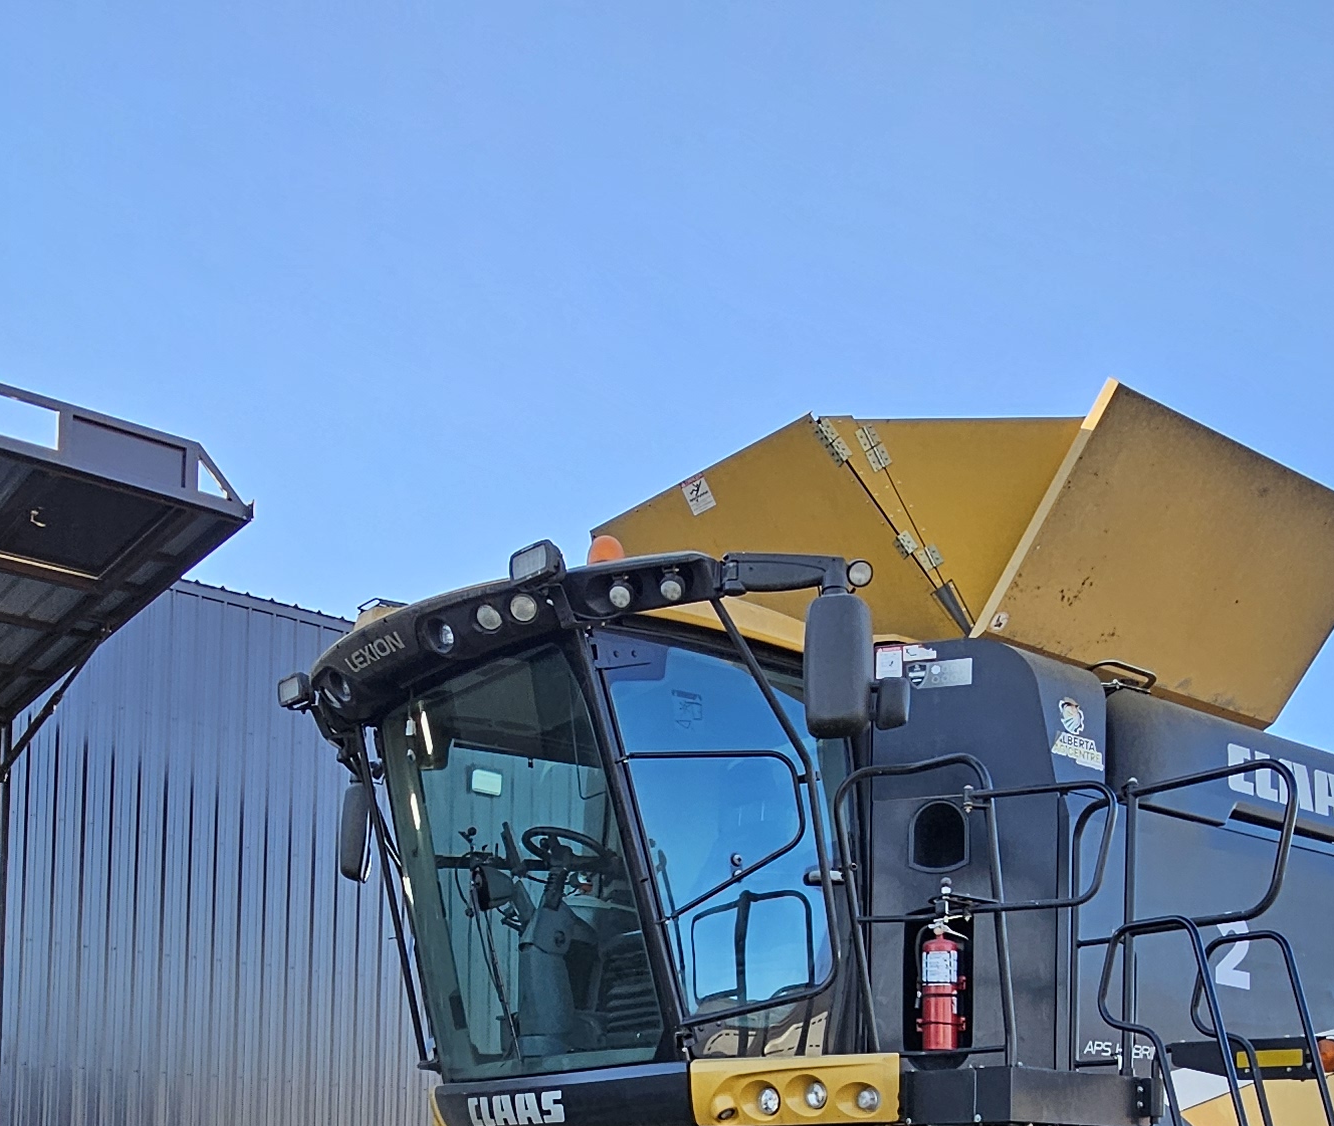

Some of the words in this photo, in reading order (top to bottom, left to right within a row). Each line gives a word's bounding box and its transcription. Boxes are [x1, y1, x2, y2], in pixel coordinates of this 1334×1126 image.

[344, 631, 406, 673] LEXION
[1215, 920, 1251, 991] 2
[1083, 1040, 1113, 1057] APS
